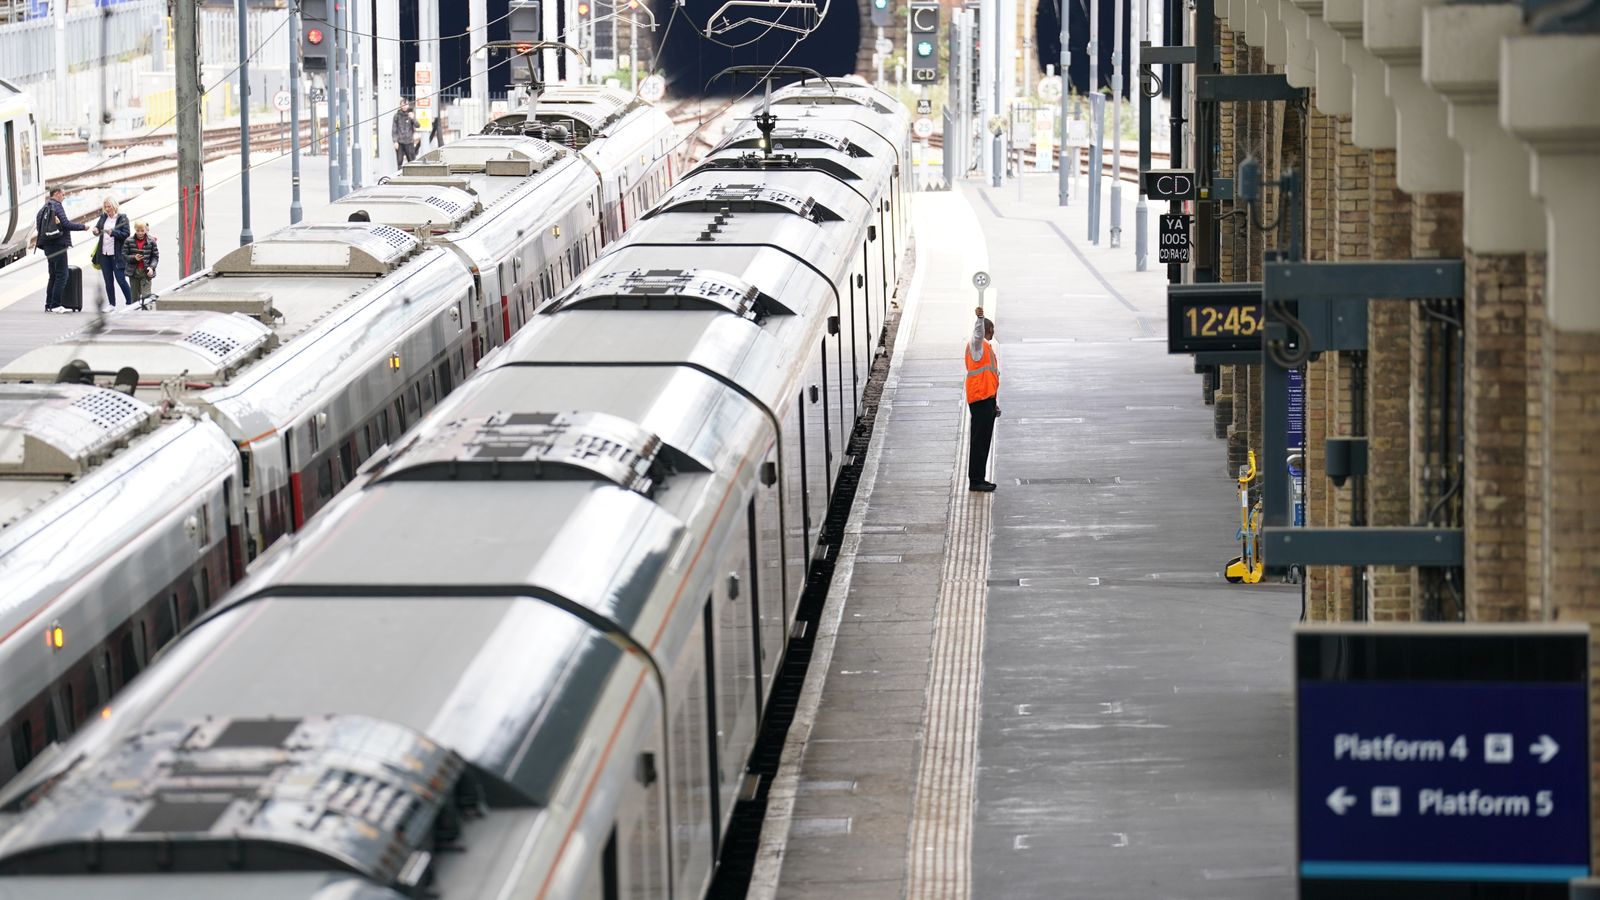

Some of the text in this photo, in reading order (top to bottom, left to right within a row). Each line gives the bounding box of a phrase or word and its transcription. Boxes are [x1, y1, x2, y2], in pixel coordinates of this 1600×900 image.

[914, 7, 935, 31] C
[916, 69, 936, 80] CD
[278, 96, 290, 106] 25
[918, 122, 930, 132] 25
[1157, 175, 1191, 195] CD
[1166, 219, 1183, 230] YA
[1162, 233, 1187, 245] 1005
[1334, 733, 1468, 761] Platform 4
[1418, 788, 1554, 817] Platform 5
